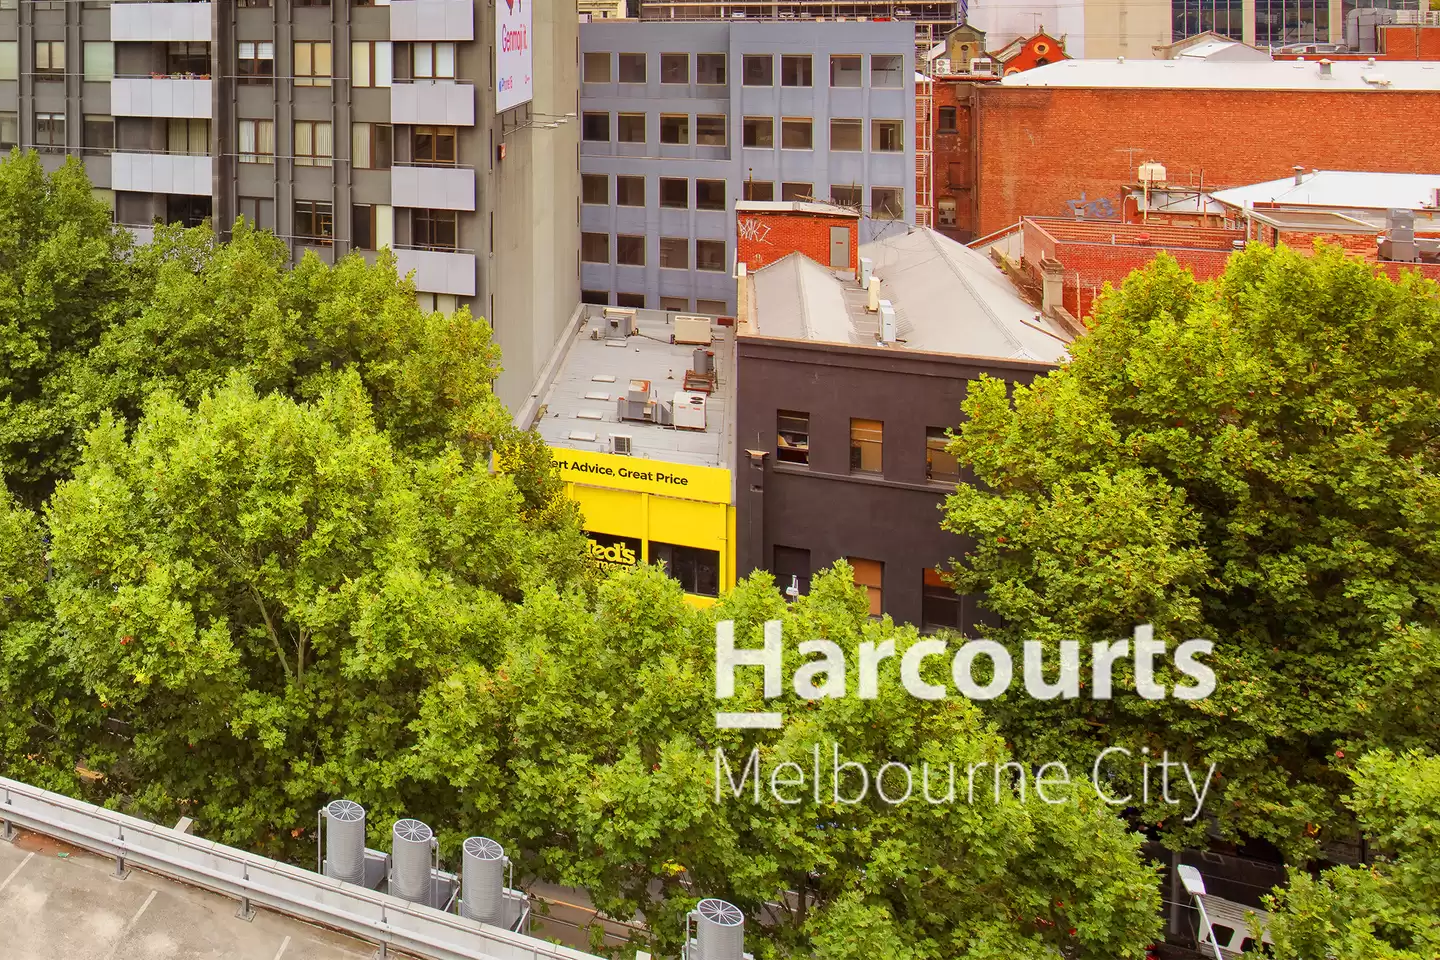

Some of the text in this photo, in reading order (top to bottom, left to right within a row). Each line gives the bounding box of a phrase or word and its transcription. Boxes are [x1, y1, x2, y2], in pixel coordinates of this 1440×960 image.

[502, 24, 522, 56] Genmoji
[551, 460, 688, 486] ert Advice, Great Price
[588, 539, 636, 564] Ted's
